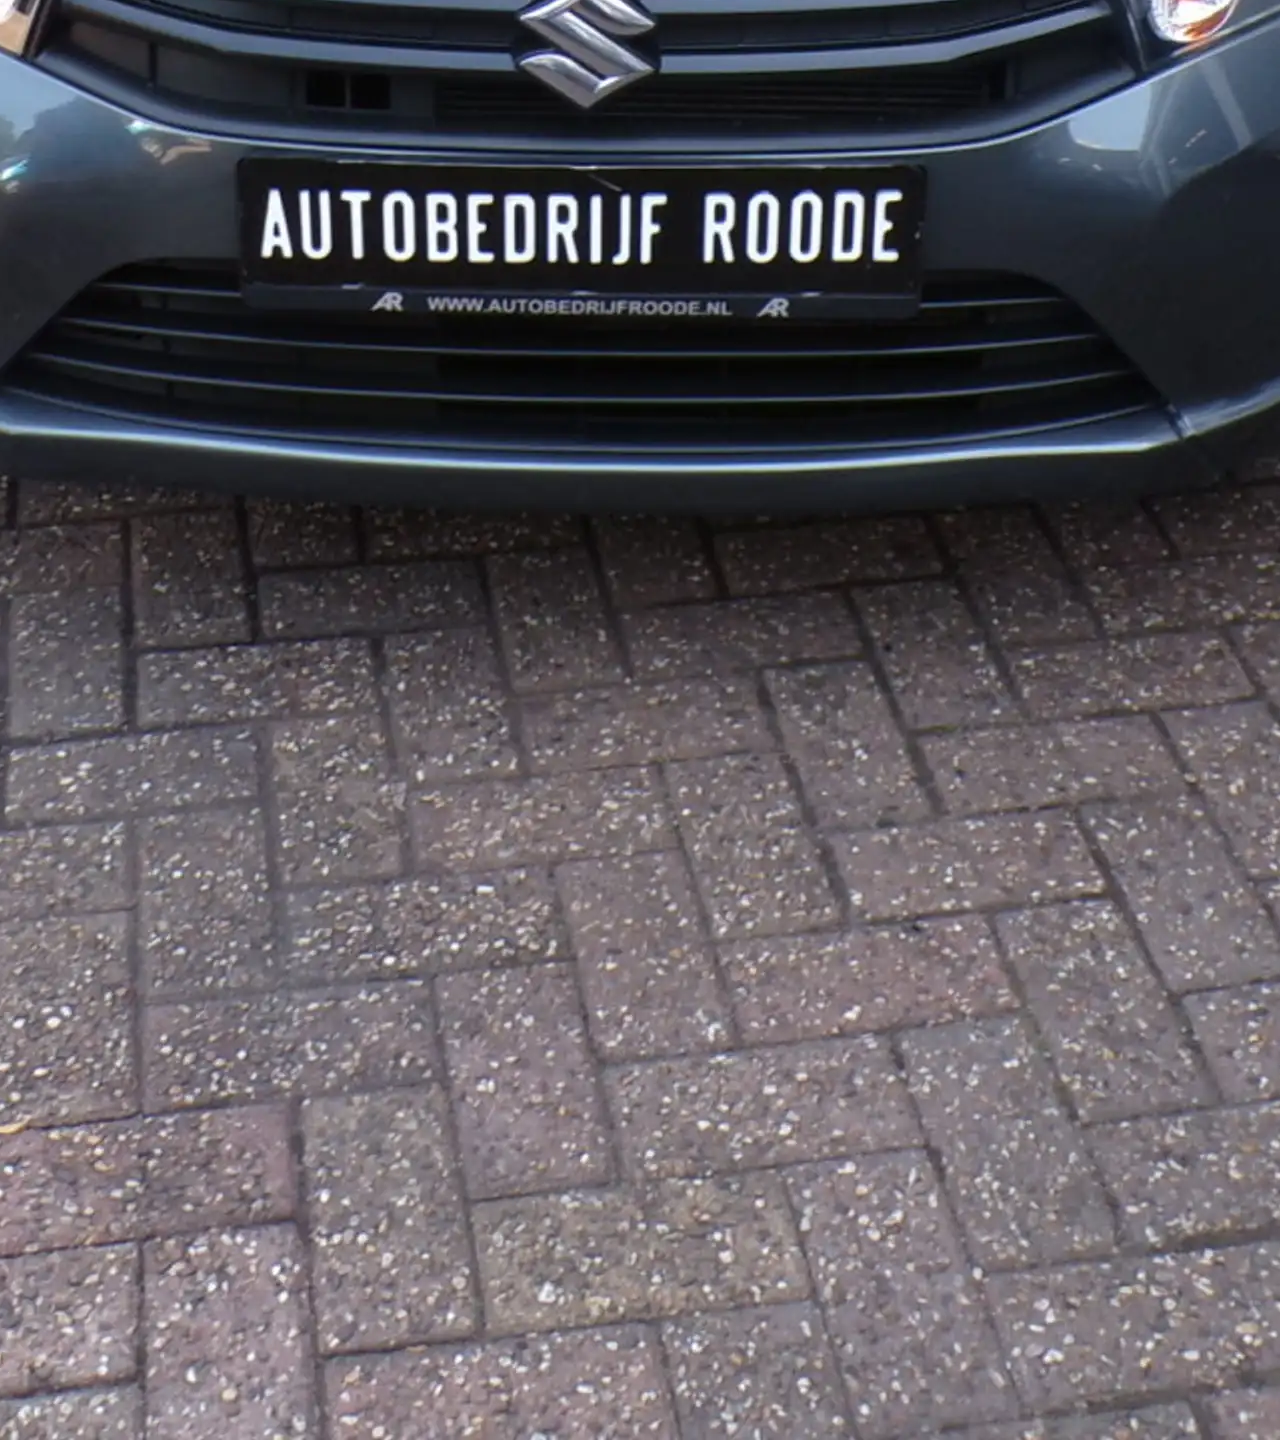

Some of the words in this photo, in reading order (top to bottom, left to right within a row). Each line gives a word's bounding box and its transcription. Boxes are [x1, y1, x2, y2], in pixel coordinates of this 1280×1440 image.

[261, 188, 669, 264] AUTOBEDRIJF
[703, 190, 904, 264] ROODE
[426, 295, 732, 317] WWW.AUTOBEDRIJFROODE.NL
